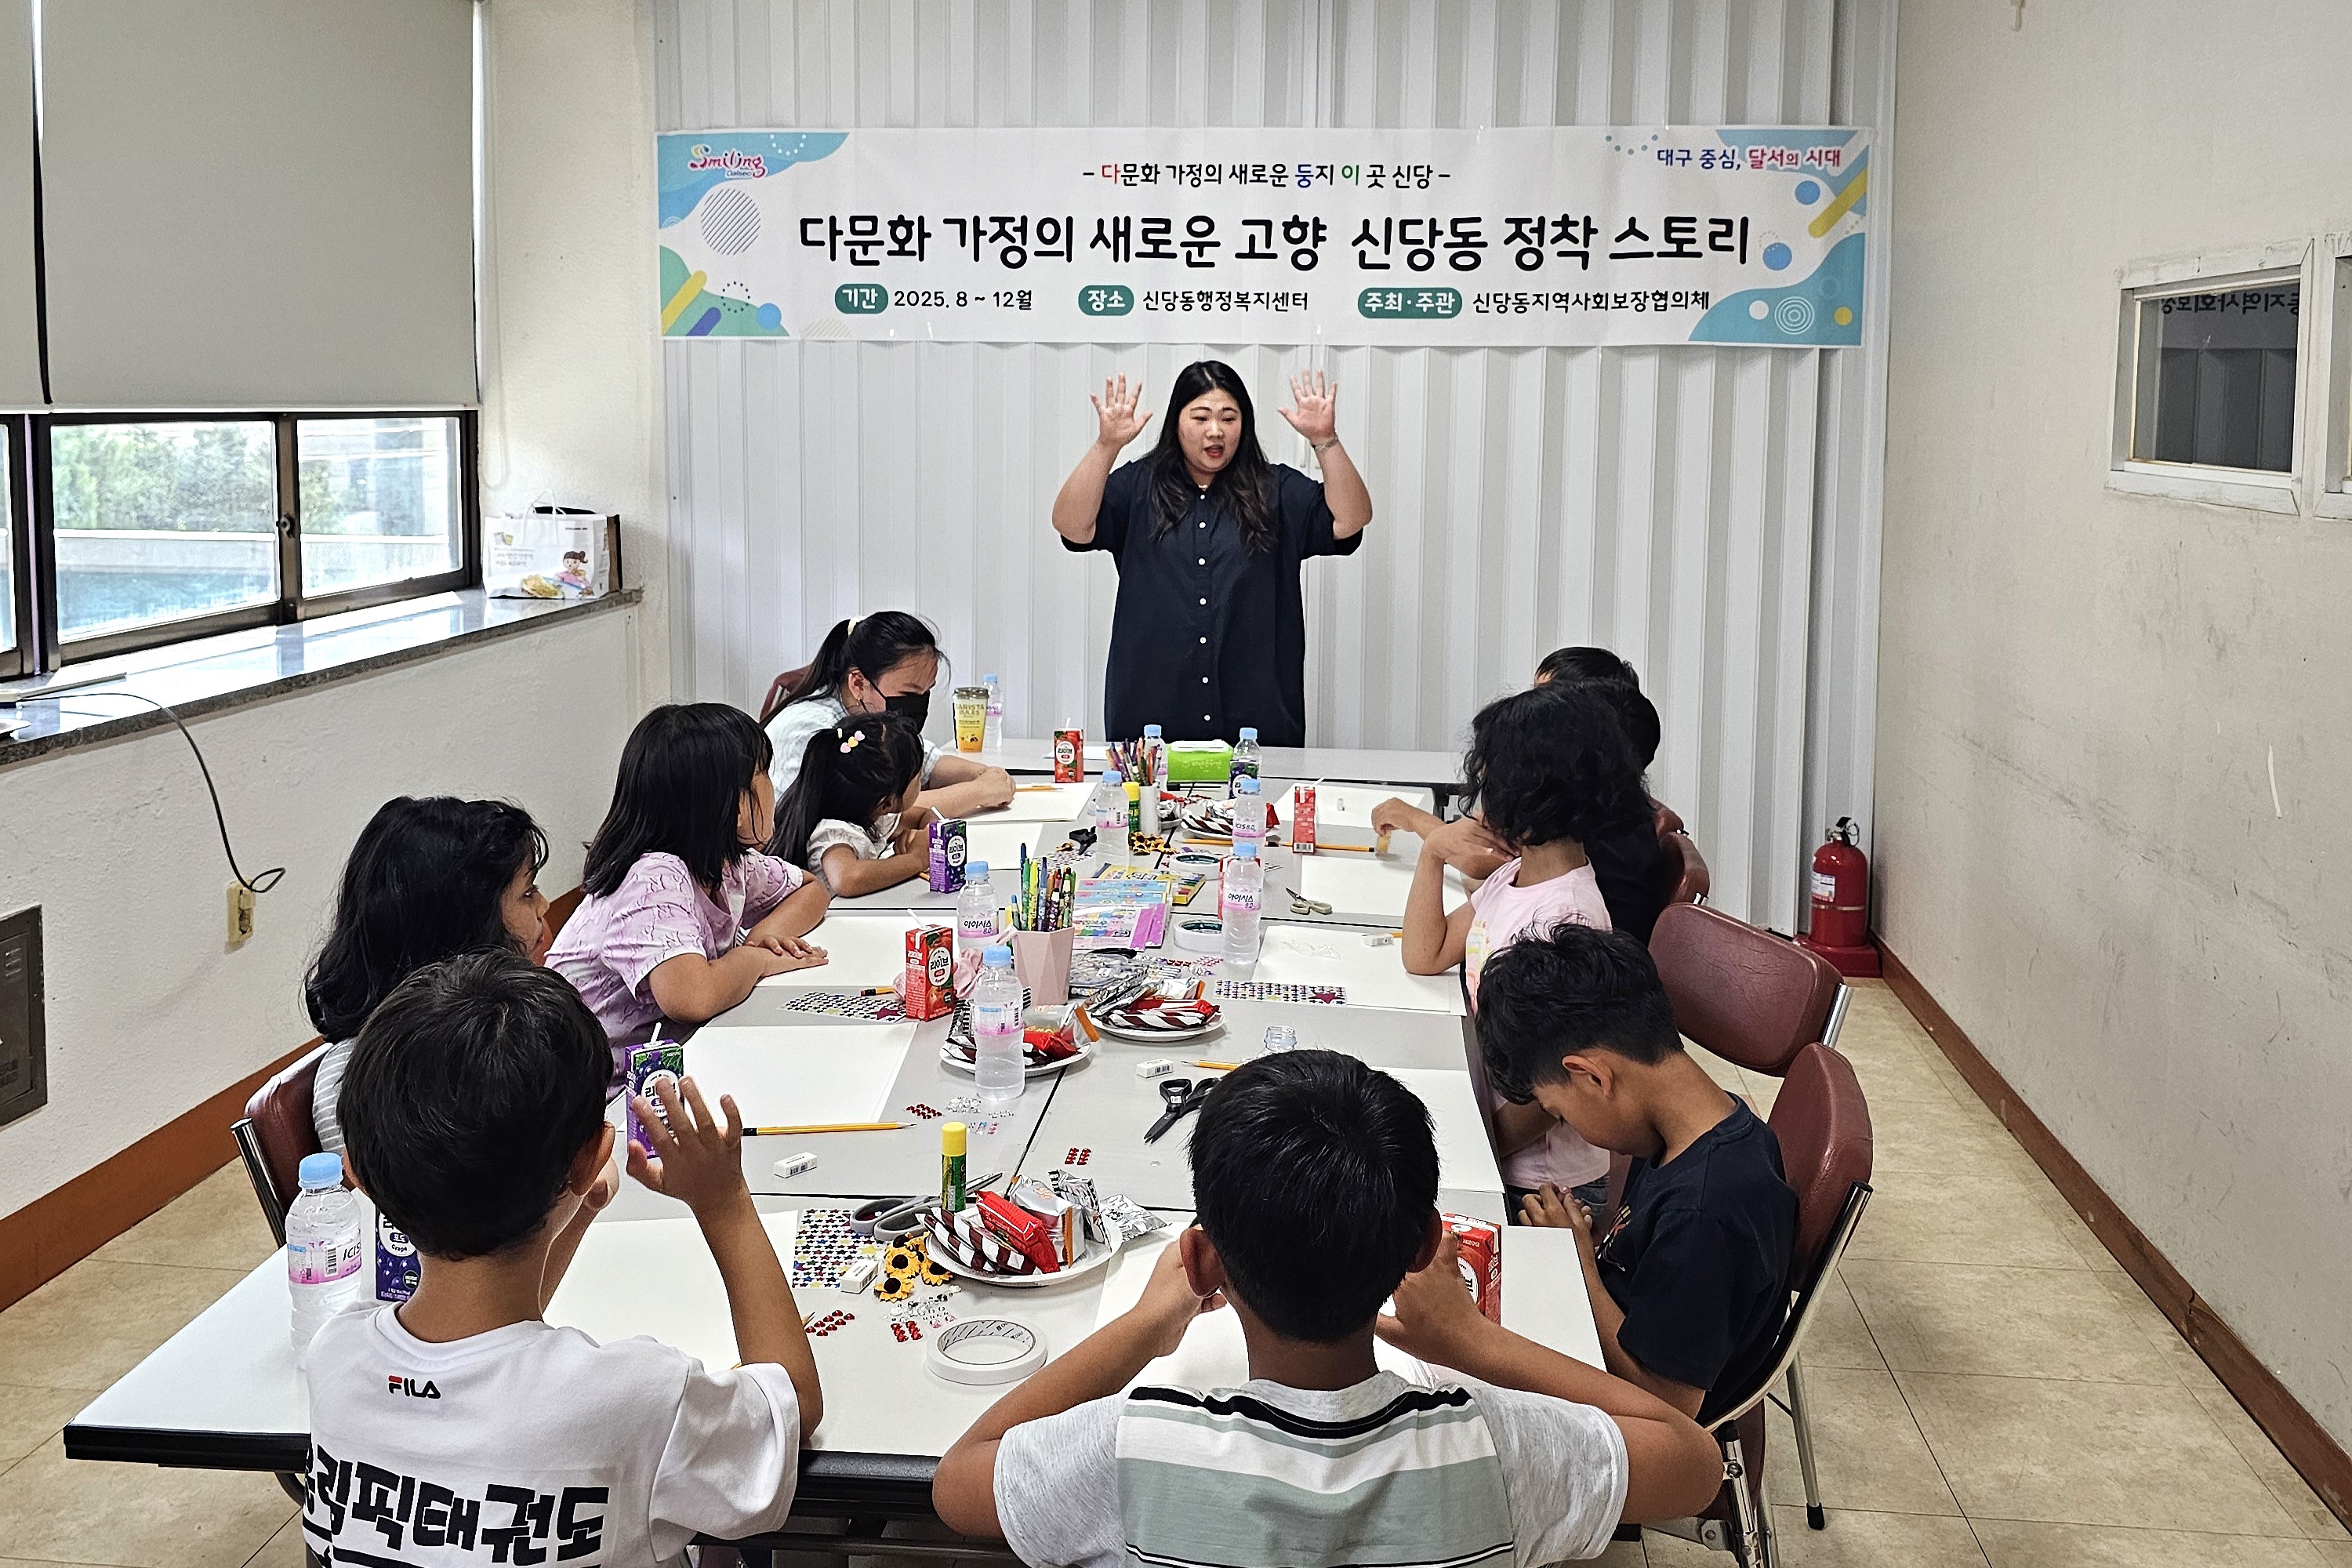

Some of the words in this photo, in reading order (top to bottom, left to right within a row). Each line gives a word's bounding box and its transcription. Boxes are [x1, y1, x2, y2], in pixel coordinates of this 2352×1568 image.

[690, 145, 766, 178] Smiling
[1657, 149, 1693, 168] 대구
[1698, 149, 1741, 171] 중심,
[1748, 149, 1799, 169] 달서의
[1805, 149, 1842, 168] 시대
[1102, 163, 1161, 187] 다문화
[1165, 163, 1223, 188] 가정의
[1229, 163, 1290, 188] 새로운
[1294, 163, 1334, 189] 둥지
[1341, 164, 1360, 187] 이
[1365, 164, 1387, 189] 곳
[1392, 164, 1434, 190] 신당
[799, 213, 933, 267] 다문화
[942, 214, 1074, 270] 가정의
[1089, 215, 1222, 269] 새로운
[1234, 213, 1328, 272] 고향
[1351, 216, 1490, 272] 신당동
[1503, 213, 1599, 272] 정착
[1608, 216, 1749, 265] 스토리
[842, 288, 878, 309] 기간
[894, 290, 950, 309] 2025.
[956, 290, 968, 307] 8
[993, 289, 1033, 311] 12월
[1087, 289, 1126, 312] 장소
[1142, 289, 1309, 312] 신당동행정복지센터
[1472, 290, 1710, 314] 신당동지역사회보장협의체
[930, 956, 949, 971] 라이브
[387, 1375, 441, 1399] FILA
[304, 1443, 610, 1566] 림픽태권도
